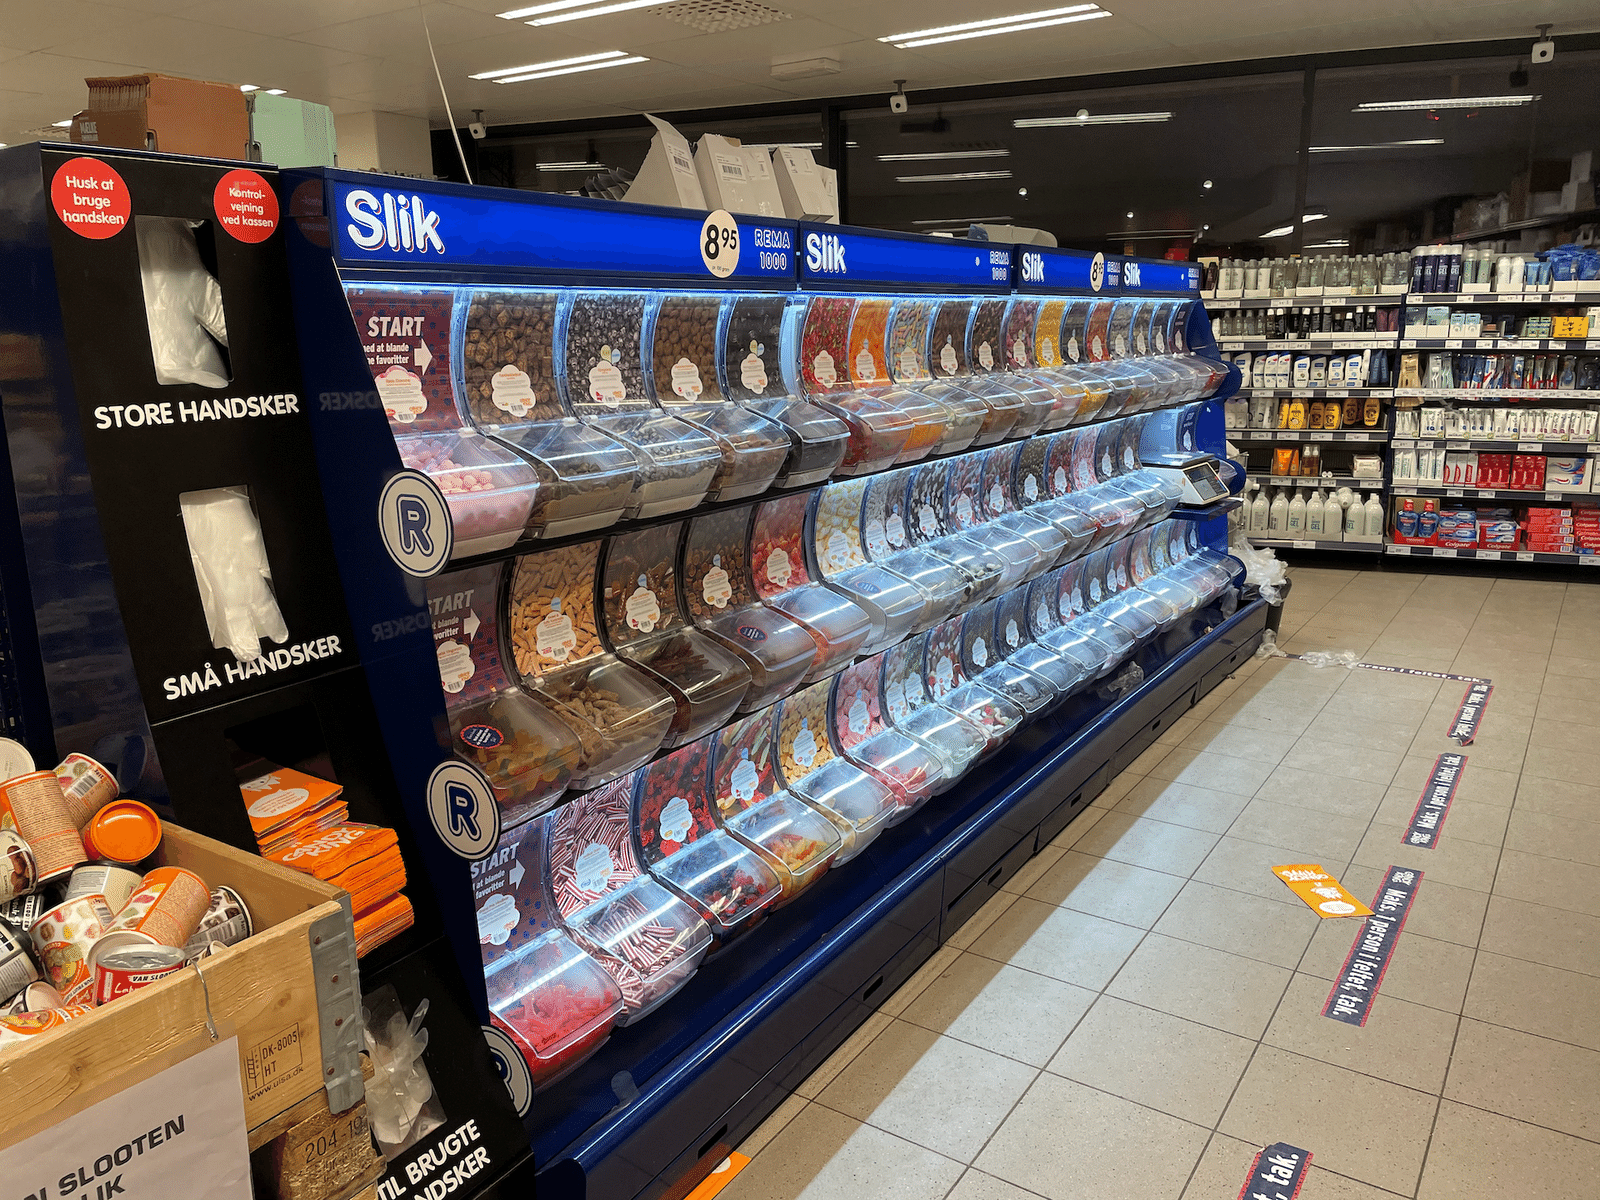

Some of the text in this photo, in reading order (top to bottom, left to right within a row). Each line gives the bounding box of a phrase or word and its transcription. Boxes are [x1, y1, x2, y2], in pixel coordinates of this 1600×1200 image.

[65, 176, 114, 191] Husk at
[229, 187, 266, 200] Kontrol-
[73, 193, 111, 209] bruge
[230, 202, 264, 216] vejning
[63, 210, 125, 225] handsken
[223, 215, 274, 228] ved kassen
[345, 190, 446, 254] Slik
[754, 228, 791, 249] REMA
[760, 251, 787, 271] 1000
[806, 232, 847, 274] Slik
[990, 251, 1009, 265] REMA
[992, 267, 1007, 280] 1000
[1022, 252, 1045, 282] Slik
[1124, 262, 1141, 287] Slik
[367, 316, 425, 337] START
[376, 342, 385, 352] at
[386, 342, 410, 352] blande
[376, 354, 409, 365] favoritter
[94, 393, 300, 429] STORE HANDSKER
[163, 635, 342, 701] SMÅ HANDSKER
[1417, 811, 1440, 829] Maks.
[1431, 785, 1451, 807] person
[1443, 755, 1461, 766] tak.
[444, 782, 481, 846] R
[470, 842, 520, 879] START
[1332, 888, 1408, 1016] Maks. 1 person i feltet, tak.
[262, 1031, 297, 1060] DK-8005
[265, 1060, 276, 1077] HT
[58, 1114, 185, 1196] SLOOTEN
[378, 1118, 481, 1200] TIL BRUGTE
[1260, 1153, 1299, 1186] tak.
